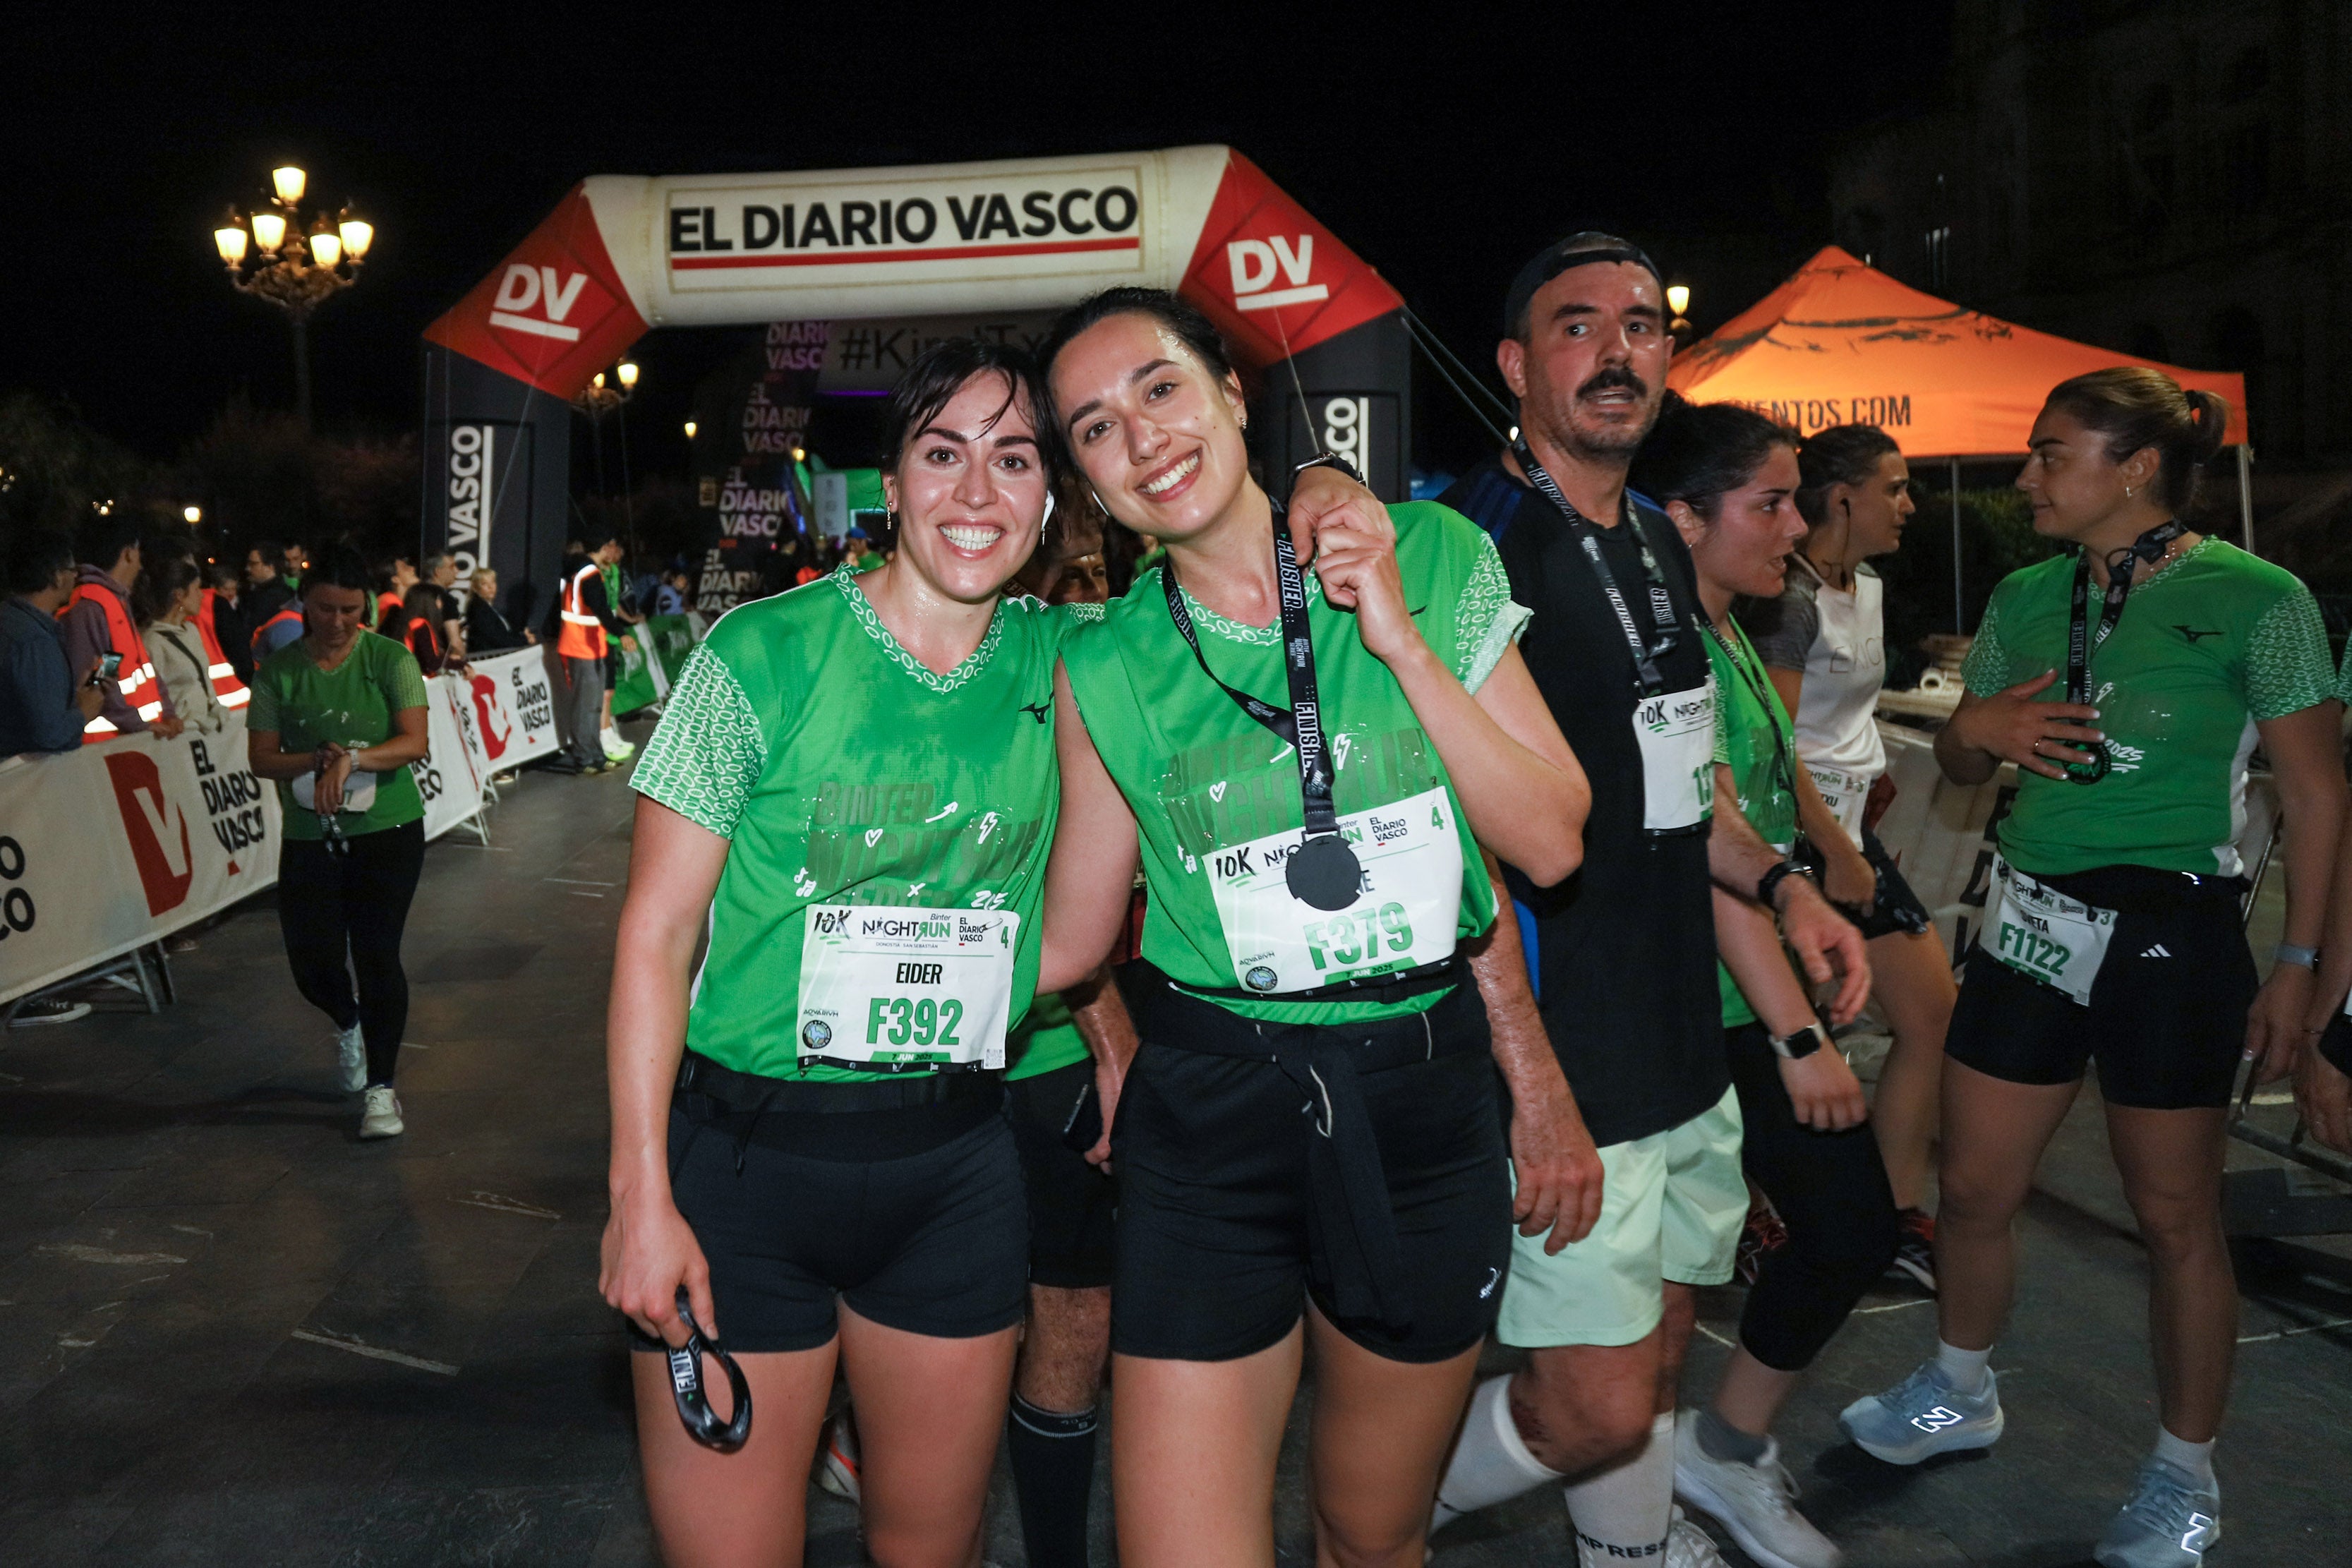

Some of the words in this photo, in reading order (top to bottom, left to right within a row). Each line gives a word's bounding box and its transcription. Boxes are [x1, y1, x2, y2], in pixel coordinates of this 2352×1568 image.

[670, 206, 732, 252] EL
[744, 197, 936, 250] DIARIO
[946, 185, 1138, 241] VASCO
[1227, 234, 1313, 294] DV
[495, 263, 588, 323] DV
[447, 425, 482, 547] VASCO
[1277, 538, 1304, 610] FINISHER
[516, 681, 548, 710] DIARIO
[519, 704, 550, 733] VASCO
[188, 739, 215, 776] EL
[814, 781, 935, 826] BINTER
[1432, 806, 1445, 831] 4
[1370, 817, 1380, 826] EL
[1372, 819, 1406, 834] DIARIO
[1375, 828, 1409, 843] VASCO
[1216, 846, 1257, 881] 10K
[814, 910, 852, 940] 10K
[2100, 911, 2111, 925] 3
[959, 934, 984, 943] VASCO
[1000, 926, 1009, 949] 4
[1303, 902, 1413, 972] F379
[1998, 921, 2070, 976] F1122
[895, 963, 943, 985] EIDER
[1353, 969, 1371, 977] JUN
[1372, 963, 1394, 975] 2025
[866, 997, 963, 1046] F392
